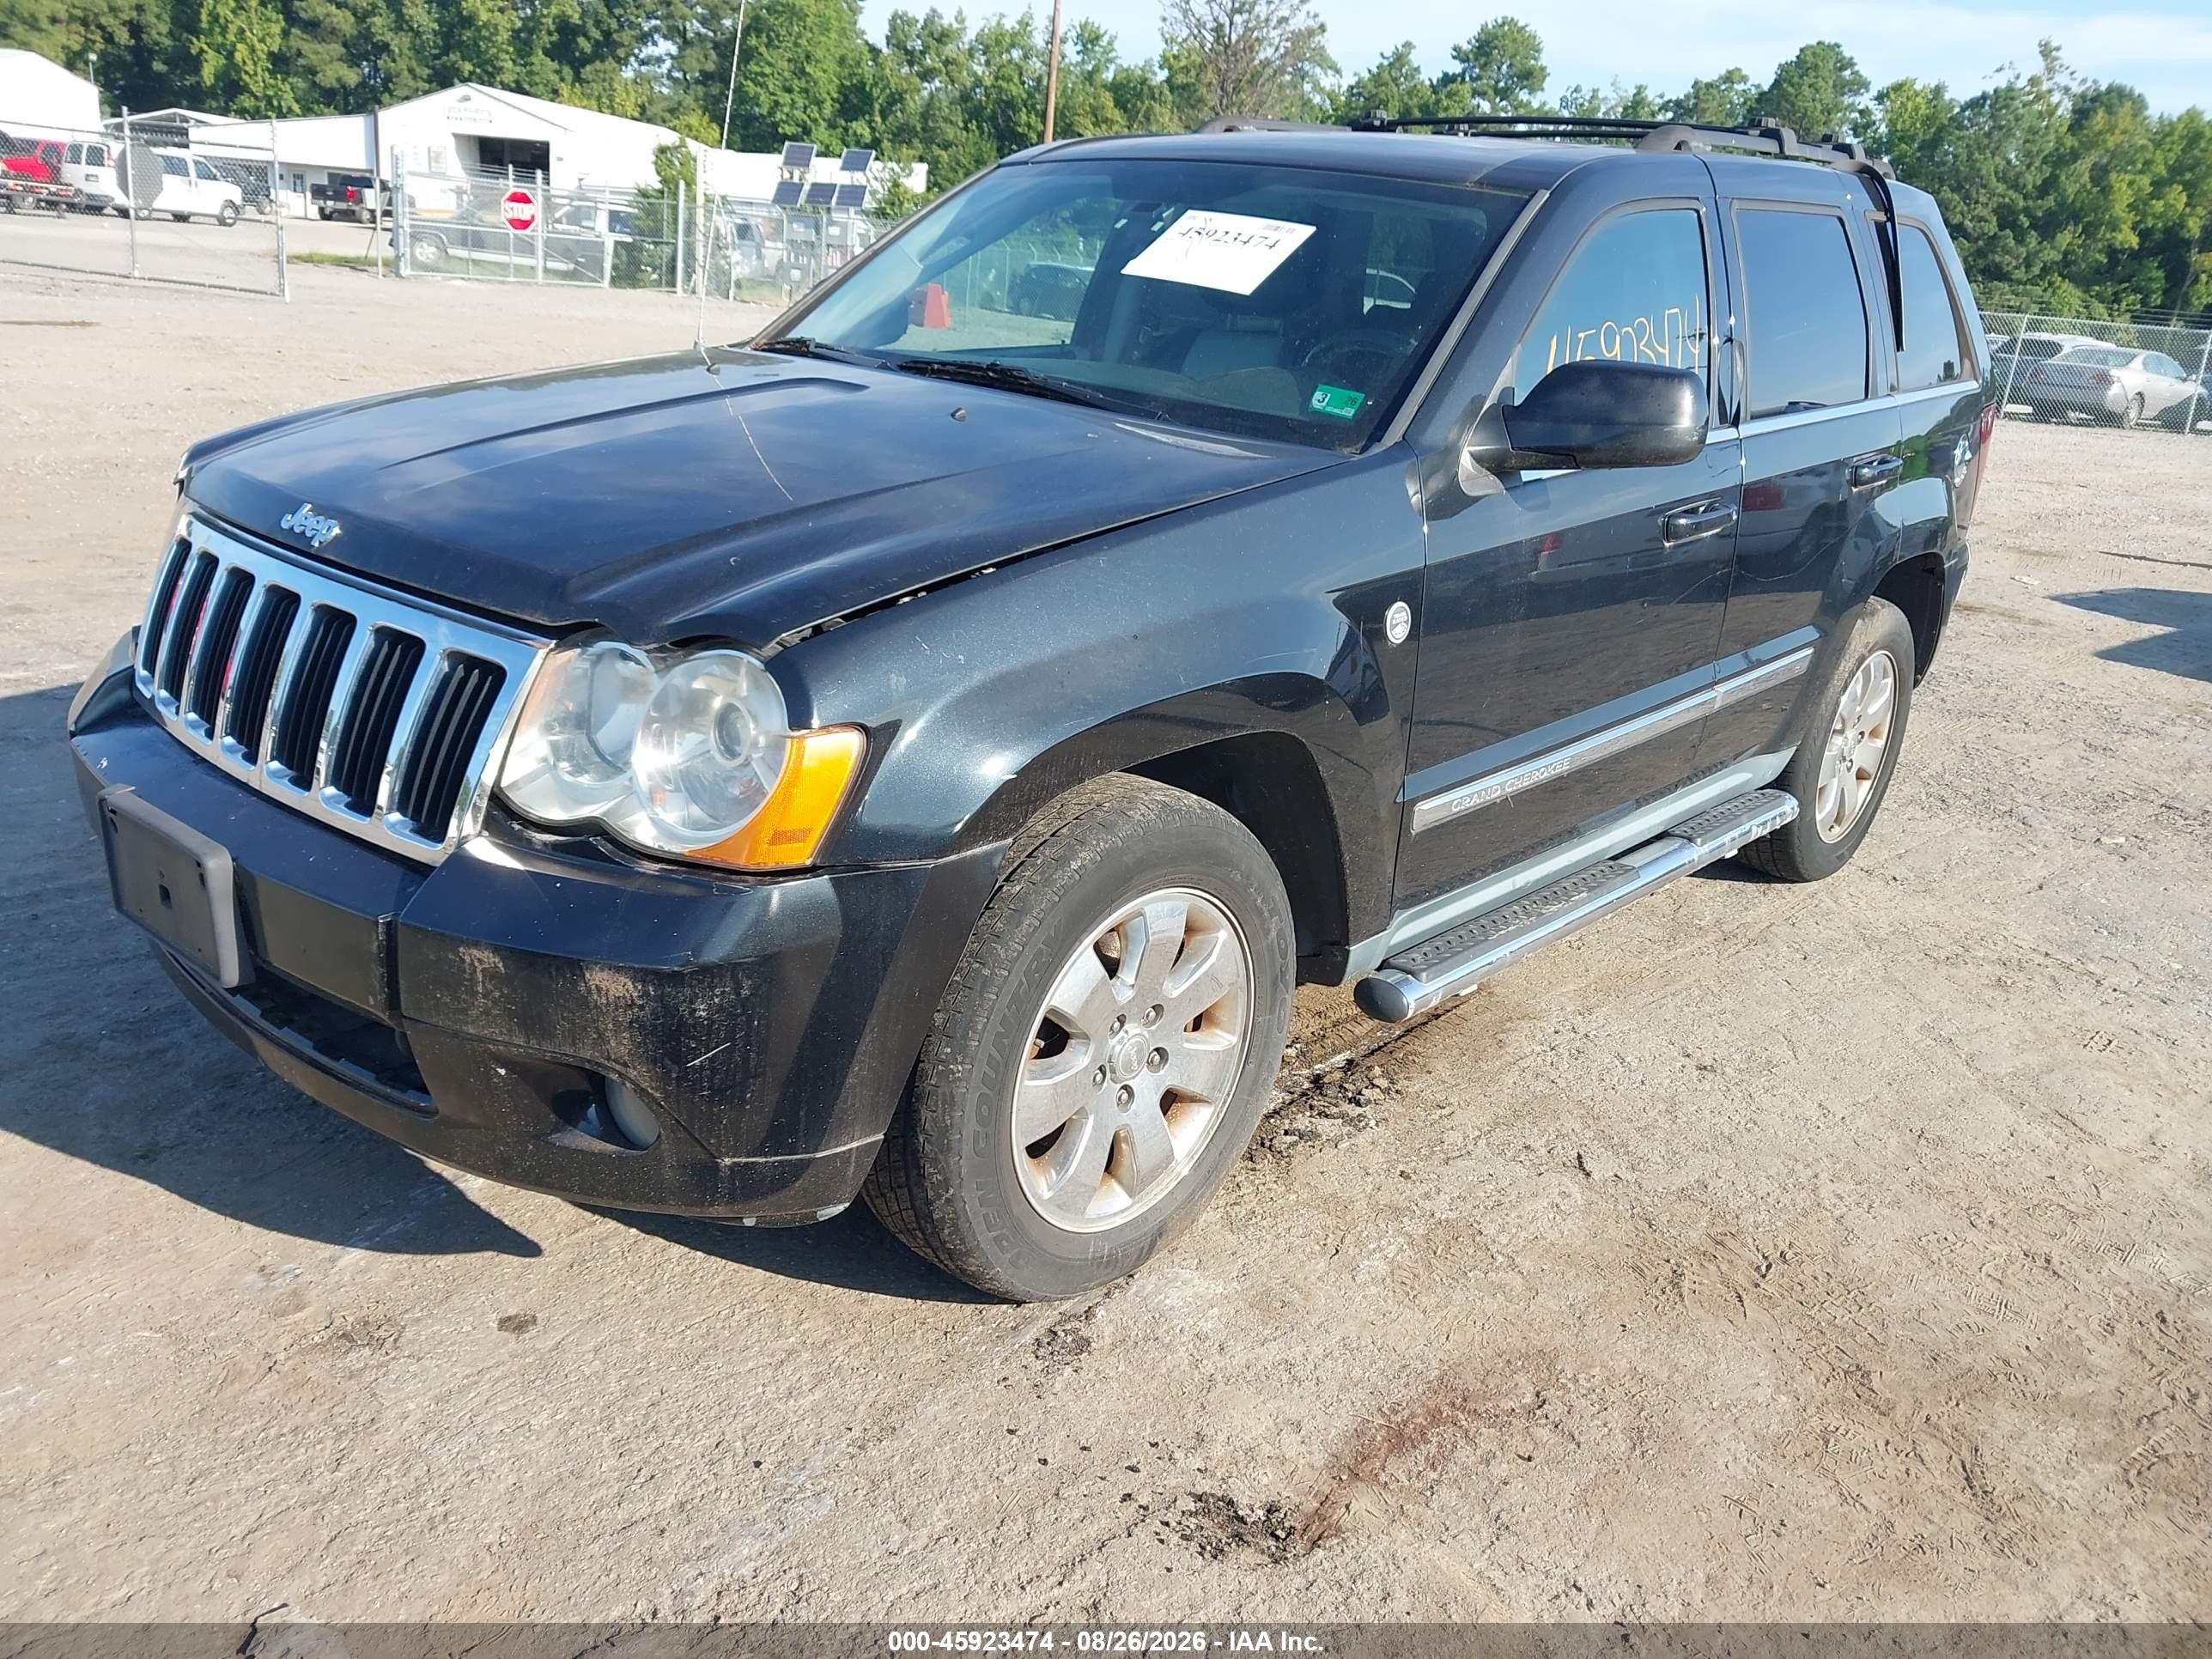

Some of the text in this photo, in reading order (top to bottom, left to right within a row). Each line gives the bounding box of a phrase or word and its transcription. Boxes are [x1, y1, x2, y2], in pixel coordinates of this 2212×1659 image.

[503, 201, 534, 221] STOP
[1317, 392, 1328, 404] 3
[1343, 396, 1358, 407] 26
[281, 502, 341, 547] Jeep
[1451, 757, 1572, 811] GRAND CHEROKEE
[972, 918, 1063, 1159] COUNTRY
